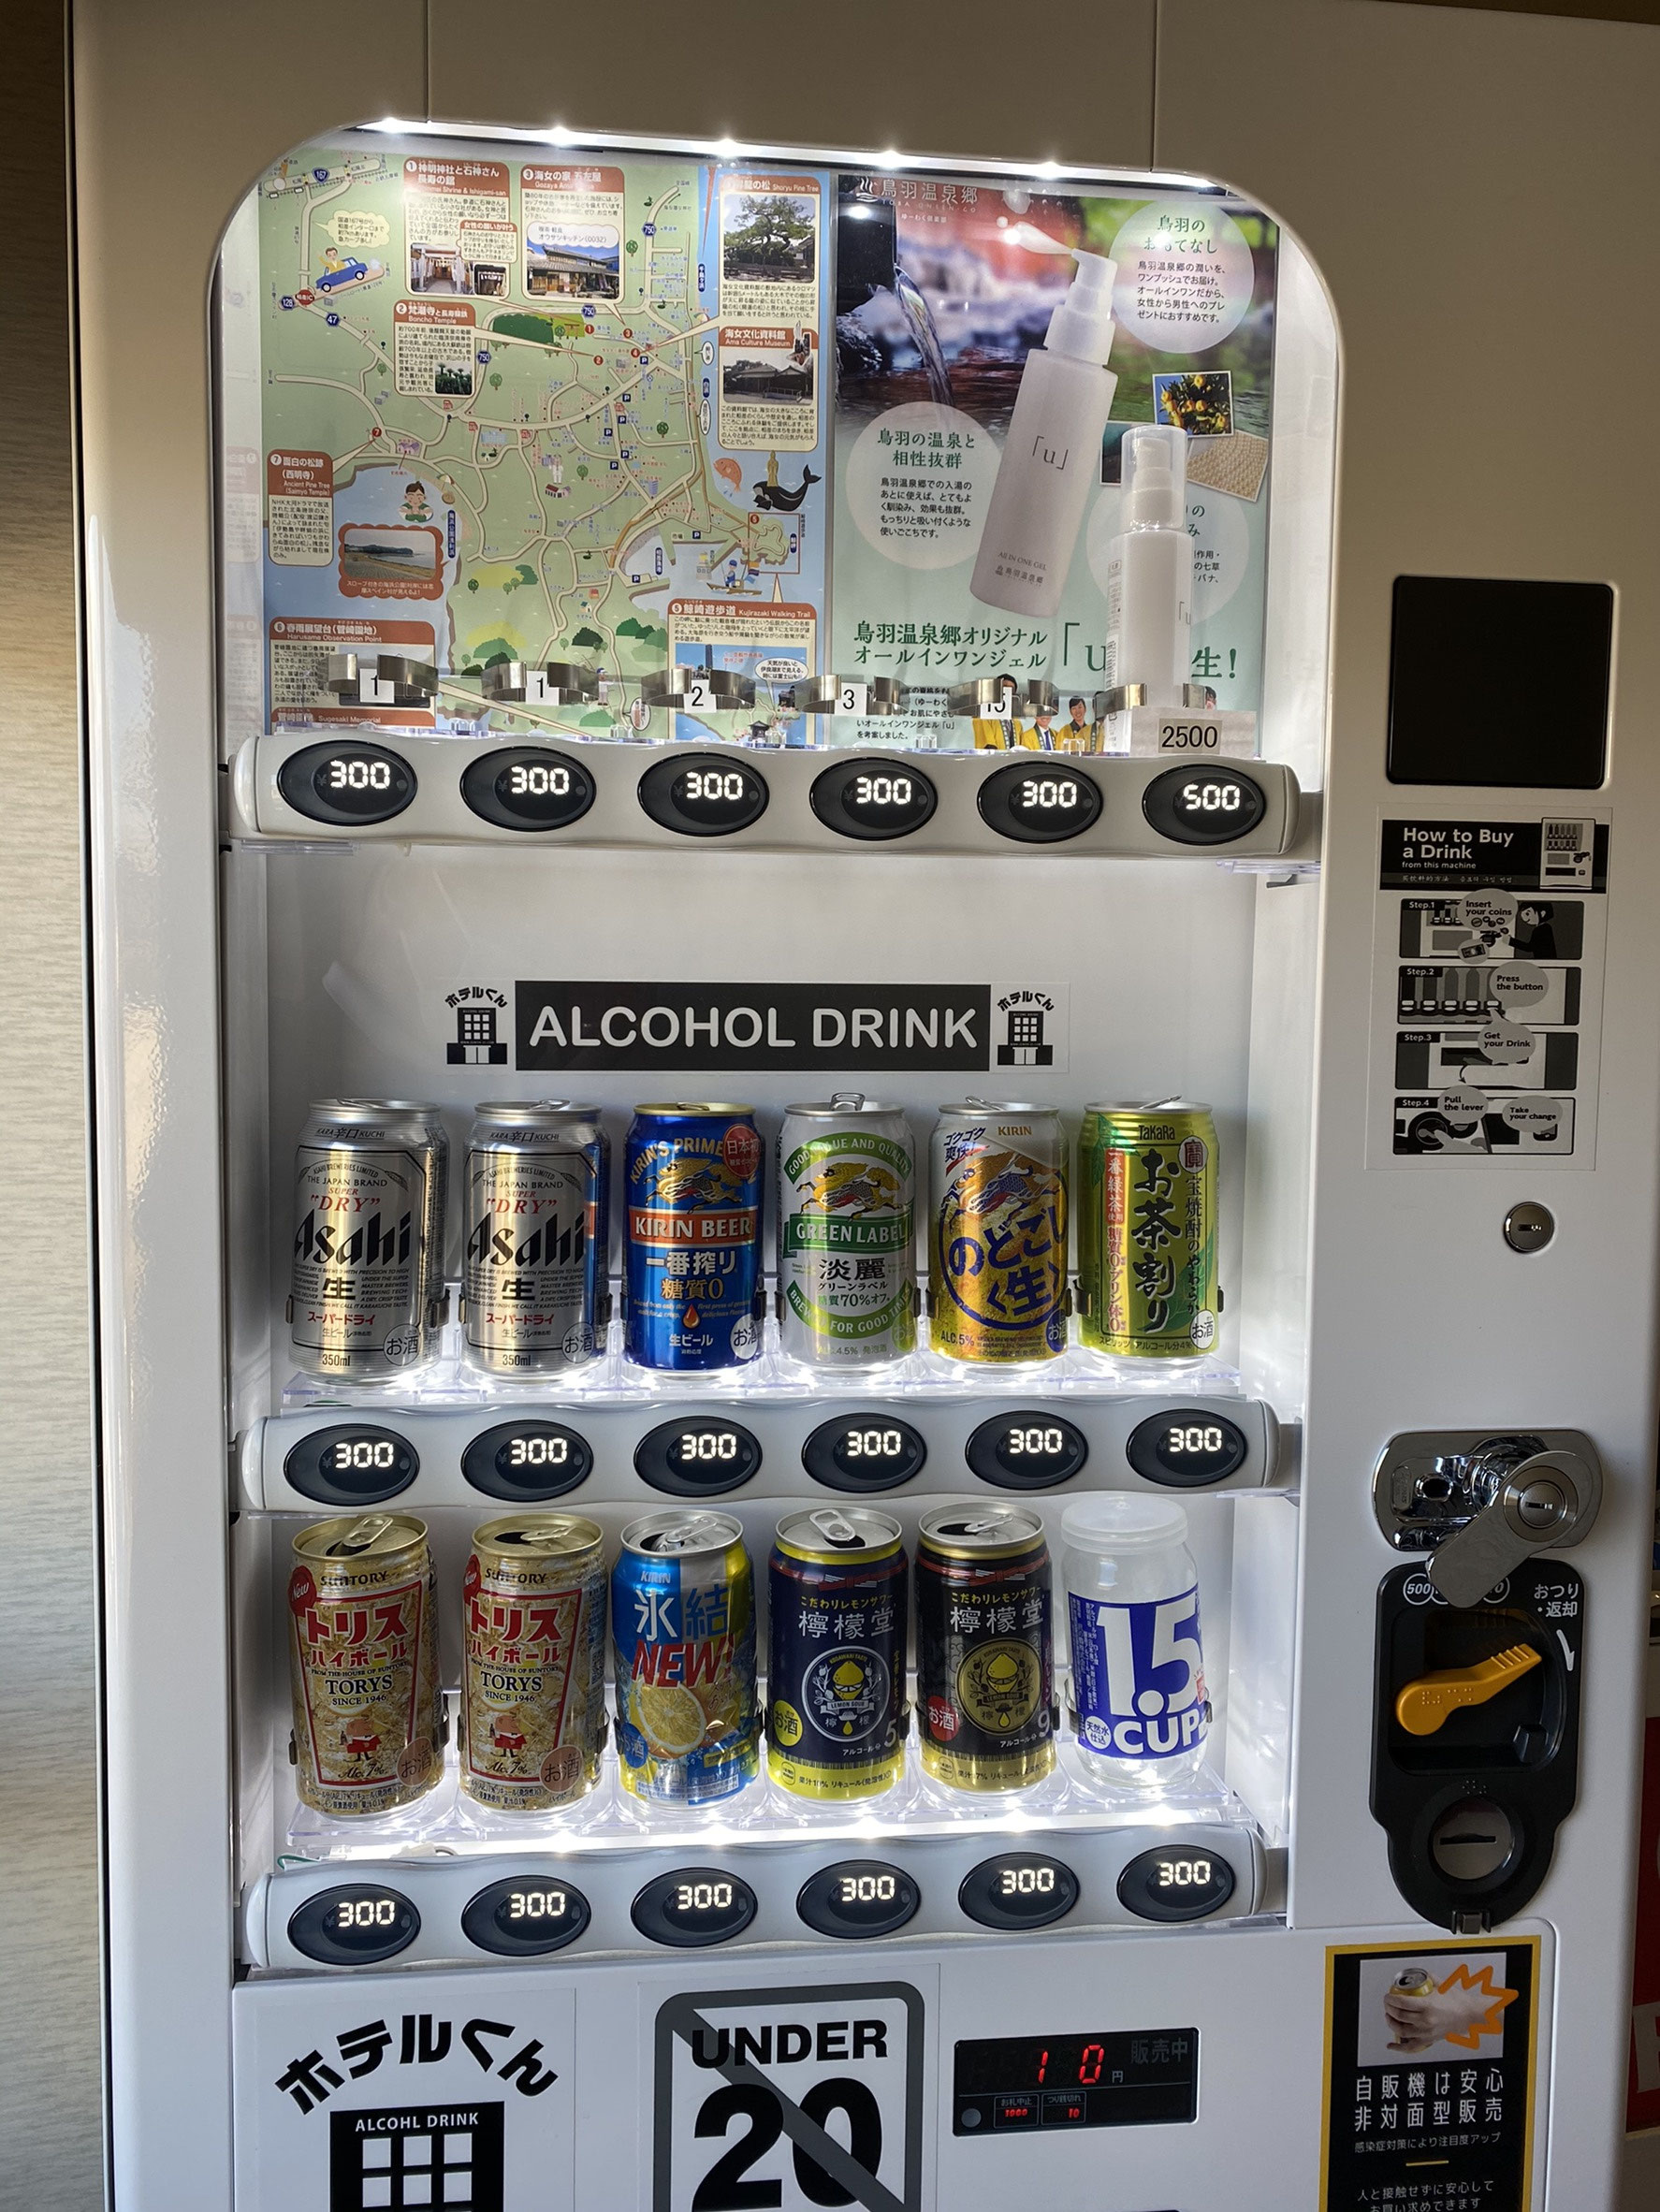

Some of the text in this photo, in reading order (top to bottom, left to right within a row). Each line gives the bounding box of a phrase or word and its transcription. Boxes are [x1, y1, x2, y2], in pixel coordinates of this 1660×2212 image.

[314, 170, 329, 181] 167
[881, 179, 978, 204] 鳥羽温泉郷
[1137, 260, 1225, 274] 鳥羽温泉郷の潤いを、
[1138, 273, 1219, 286] ワンプッシュでお届け。
[1137, 286, 1225, 298] オールインワンだから、
[281, 298, 294, 308] 128
[583, 306, 594, 316] 750
[1137, 298, 1225, 311] 女性から男性へのプレ
[328, 314, 338, 325] 47
[1137, 311, 1220, 323] ゼントにおすすめです。
[725, 328, 785, 340] 海女文化資料館
[877, 428, 975, 449] 鳥羽の温泉と
[893, 450, 963, 470] 相性抜群
[881, 477, 972, 490] 鳥羽温泉郷での入湯の
[881, 489, 972, 502] あとに使えば、とてもよ
[881, 502, 966, 515] く馴染み、効果も抜群。
[881, 515, 971, 528] もっちりと吸い付くような
[881, 527, 939, 538] 使いごこちです。
[738, 609, 770, 618] Kujirazaki
[771, 610, 796, 618] Walking
[323, 634, 363, 643] Observation
[853, 620, 1048, 647] 鳥羽温泉郷オリジナル
[853, 646, 1047, 669] オールインワンジェル
[371, 675, 378, 696] 1
[536, 677, 545, 699] 1
[692, 686, 704, 706] 2
[843, 689, 854, 709] 3
[318, 715, 349, 724] Sugesaki
[857, 731, 908, 740] を考案しました。
[1162, 726, 1217, 748] 2500
[329, 761, 390, 789] 300
[512, 766, 569, 794] 300
[687, 772, 743, 799] 300
[856, 777, 910, 805] 300
[1023, 781, 1077, 808] 300
[1185, 784, 1240, 810] 500
[1404, 827, 1514, 848] How to Buy
[1403, 845, 1473, 859] a Drink
[1408, 900, 1435, 910] Step.1
[1465, 908, 1512, 917] your coins
[1406, 968, 1434, 977] Step.2
[444, 986, 507, 1008] ホテルくん
[1496, 982, 1544, 991] the button
[997, 990, 1055, 1011] ホテルくん
[529, 1005, 978, 1050] ALCOHOL DRINK
[1404, 1033, 1432, 1042] Step.3
[1484, 1031, 1501, 1040] Get
[1402, 1099, 1430, 1108] Step.4
[1444, 1096, 1462, 1104] Pull
[1528, 1113, 1556, 1121] change
[943, 1128, 986, 1147] ゴクゴク
[630, 1137, 723, 1186] KIRIN'S PRIME
[328, 1187, 358, 1196] SUPER
[295, 1209, 411, 1266] Asahi
[635, 1216, 752, 1238] KIRIN BEER
[796, 1222, 905, 1244] GREEN LABEL
[949, 1206, 1066, 1277] のどごし
[1131, 1148, 1182, 1333] お茶割り
[1185, 1176, 1202, 1316] 宝焼酎のやわらか
[646, 1251, 736, 1275] 一番搾り
[819, 1258, 886, 1281] 淡麗
[323, 1277, 356, 1300] 生
[661, 1277, 724, 1301] 糖質0
[818, 1282, 888, 1292] グリーンラベル
[308, 1312, 376, 1326] スーパードライ
[669, 1333, 713, 1347] 生ビール
[322, 1354, 351, 1367] 350ml
[680, 1433, 736, 1460] 300
[848, 1430, 901, 1456] 300
[1010, 1428, 1062, 1454] 300
[1169, 1427, 1221, 1452] 300
[336, 1442, 394, 1468] 300
[511, 1437, 567, 1464] 300
[320, 1570, 387, 1586] SUNTORY
[1406, 1583, 1431, 1594] 500
[1534, 1583, 1579, 1599] おつり
[800, 1594, 893, 1610] こだわりレモンサワー
[634, 1584, 728, 1642] 氷結
[798, 1607, 894, 1640] 檸檬堂
[305, 1603, 409, 1646] トリス
[311, 1643, 408, 1667] ハイボール
[1097, 1598, 1202, 1717] 1.5
[326, 1675, 393, 1695] TORYS
[332, 1695, 386, 1706] SINCE 1946
[1114, 1708, 1201, 1754] CUP
[544, 1755, 580, 1783] お酒
[1001, 1868, 1055, 1895] 300
[1159, 1860, 1211, 1886] 300
[677, 1883, 732, 1910] 300
[841, 1876, 895, 1902] 300
[338, 1899, 395, 1928] 300
[510, 1891, 565, 1918] 300
[692, 2019, 888, 2069] UNDER
[1130, 2038, 1188, 2065] 販売中
[274, 2014, 560, 2116] ホテルくん
[1112, 2070, 1124, 2084] 円
[1356, 2067, 1504, 2102] 自販機は安心
[355, 2112, 479, 2132] ALCOHL DRINK
[1004, 2108, 1028, 2118] 1000
[1068, 2107, 1080, 2118] 10
[1355, 2097, 1503, 2132] 非対面型販売
[692, 2077, 882, 2212] 20
[1355, 2132, 1501, 2154] 感染症対策により注目度アップ
[1358, 2179, 1494, 2202] 人と接触せずに安心して
[1370, 2197, 1482, 2212] お買い求めできます
